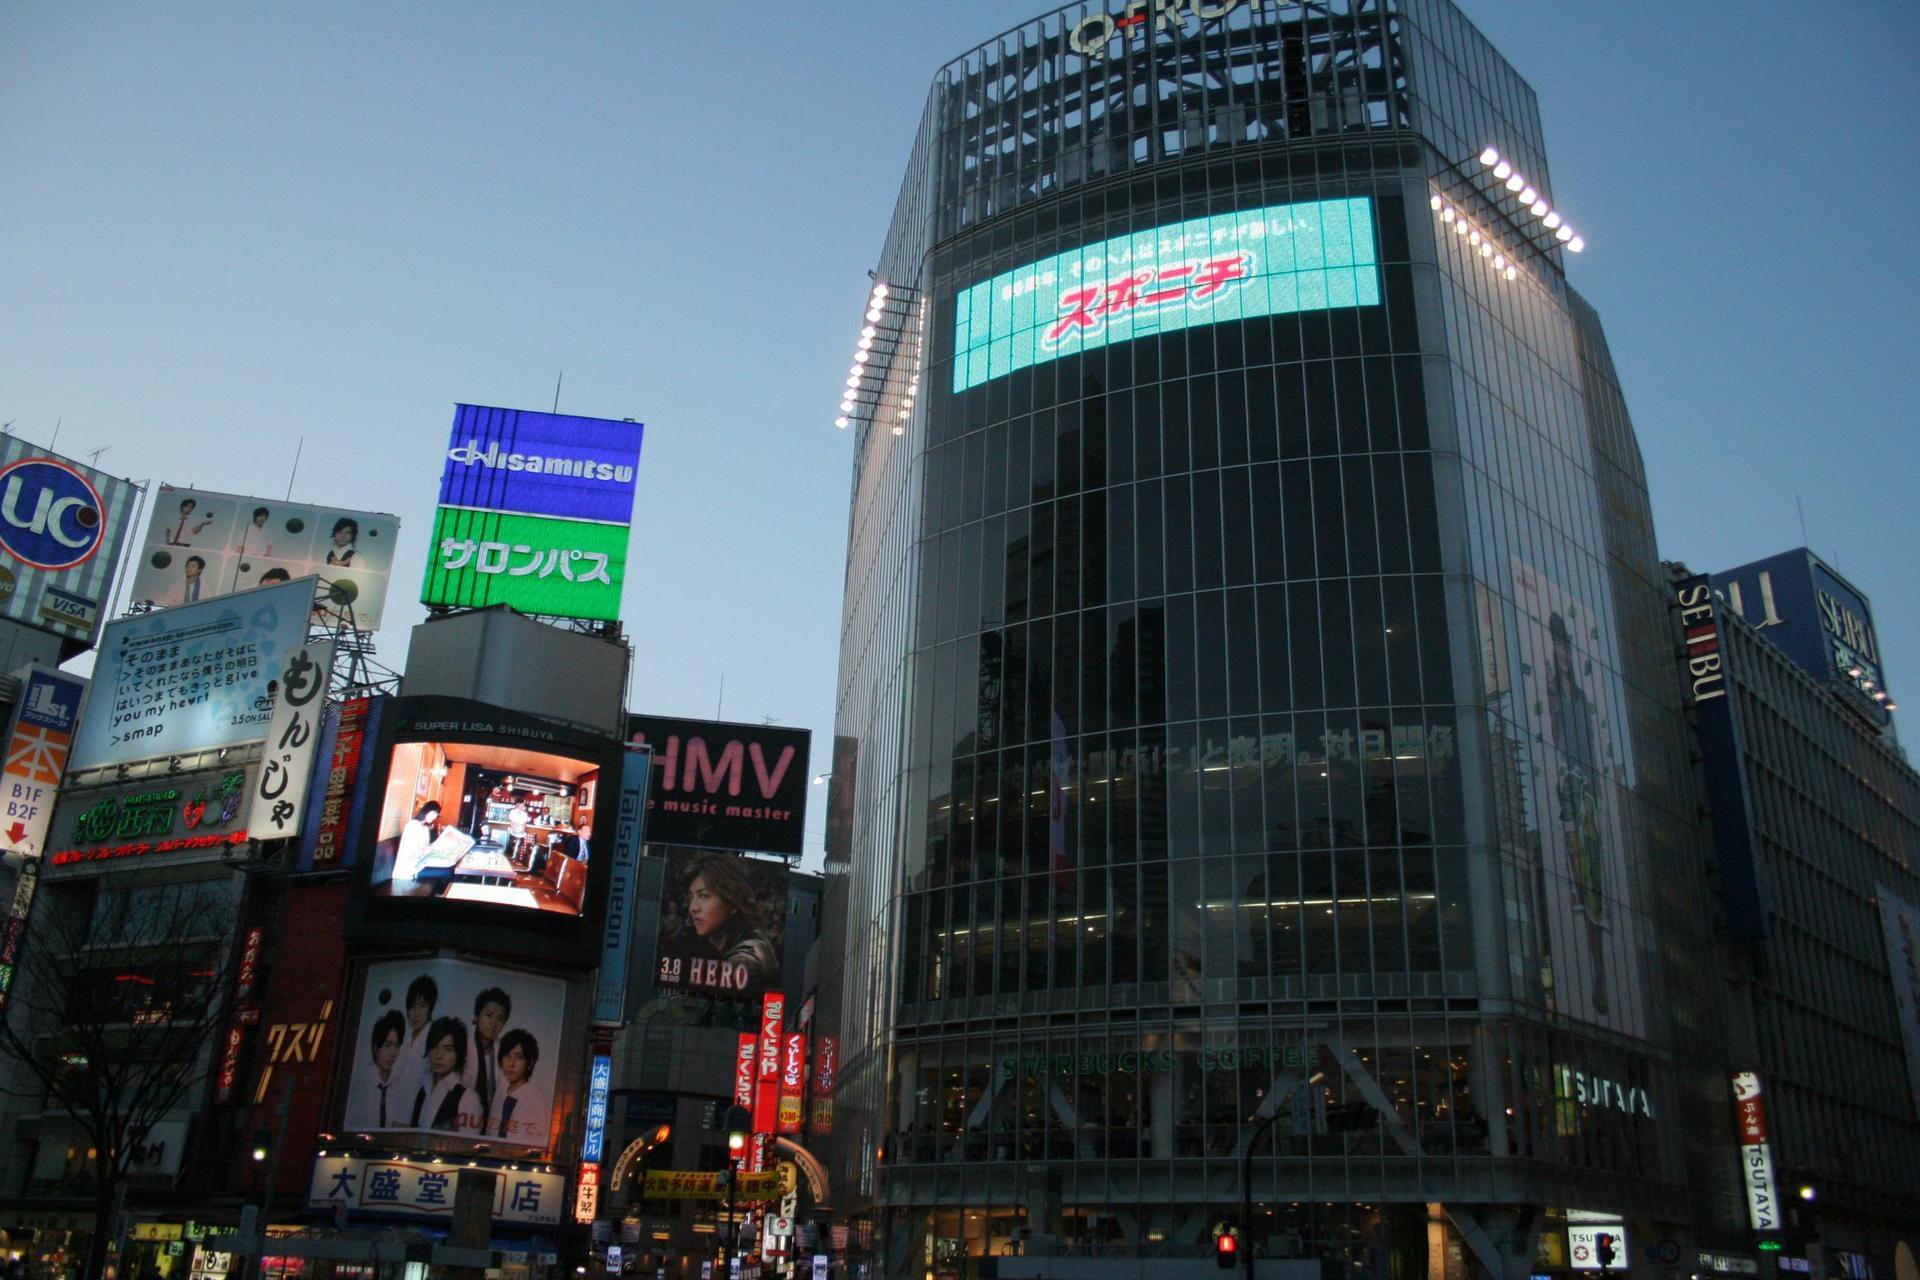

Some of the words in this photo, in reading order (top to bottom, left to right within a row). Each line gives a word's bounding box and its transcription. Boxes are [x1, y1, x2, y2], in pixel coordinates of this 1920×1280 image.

[1046, 254, 1248, 341] スポニチ
[448, 440, 633, 483] Hisamitsu
[1, 475, 90, 549] UC
[441, 537, 611, 585] サロンパス
[53, 598, 86, 618] VISA
[1817, 588, 1880, 666] SEIBU
[125, 646, 181, 667] そのまま
[1679, 585, 1726, 702] SEIBU
[113, 711, 141, 727] you
[145, 703, 166, 717] my
[414, 721, 459, 731] SUPER
[463, 722, 494, 732] LISA
[499, 724, 554, 740] SHIBUYA
[260, 650, 322, 830] もんじゃ
[632, 731, 796, 800] HMV
[7, 801, 39, 821] B2F
[12, 783, 43, 802] B1F
[663, 799, 718, 815] music
[726, 803, 792, 822] master
[616, 783, 640, 867] Taisei
[607, 875, 626, 949] neon
[660, 956, 681, 975] 3.8
[689, 956, 748, 990] HERO
[761, 1001, 782, 1075] さくらや
[738, 1044, 755, 1105] さくらや
[1002, 1048, 1177, 1080] STARBUCKS
[1199, 1045, 1320, 1072] COFFEE
[328, 1166, 543, 1213] 大盛堂店
[1749, 1145, 1772, 1229] TSUTAYA
[1571, 1233, 1622, 1243] TSUA
